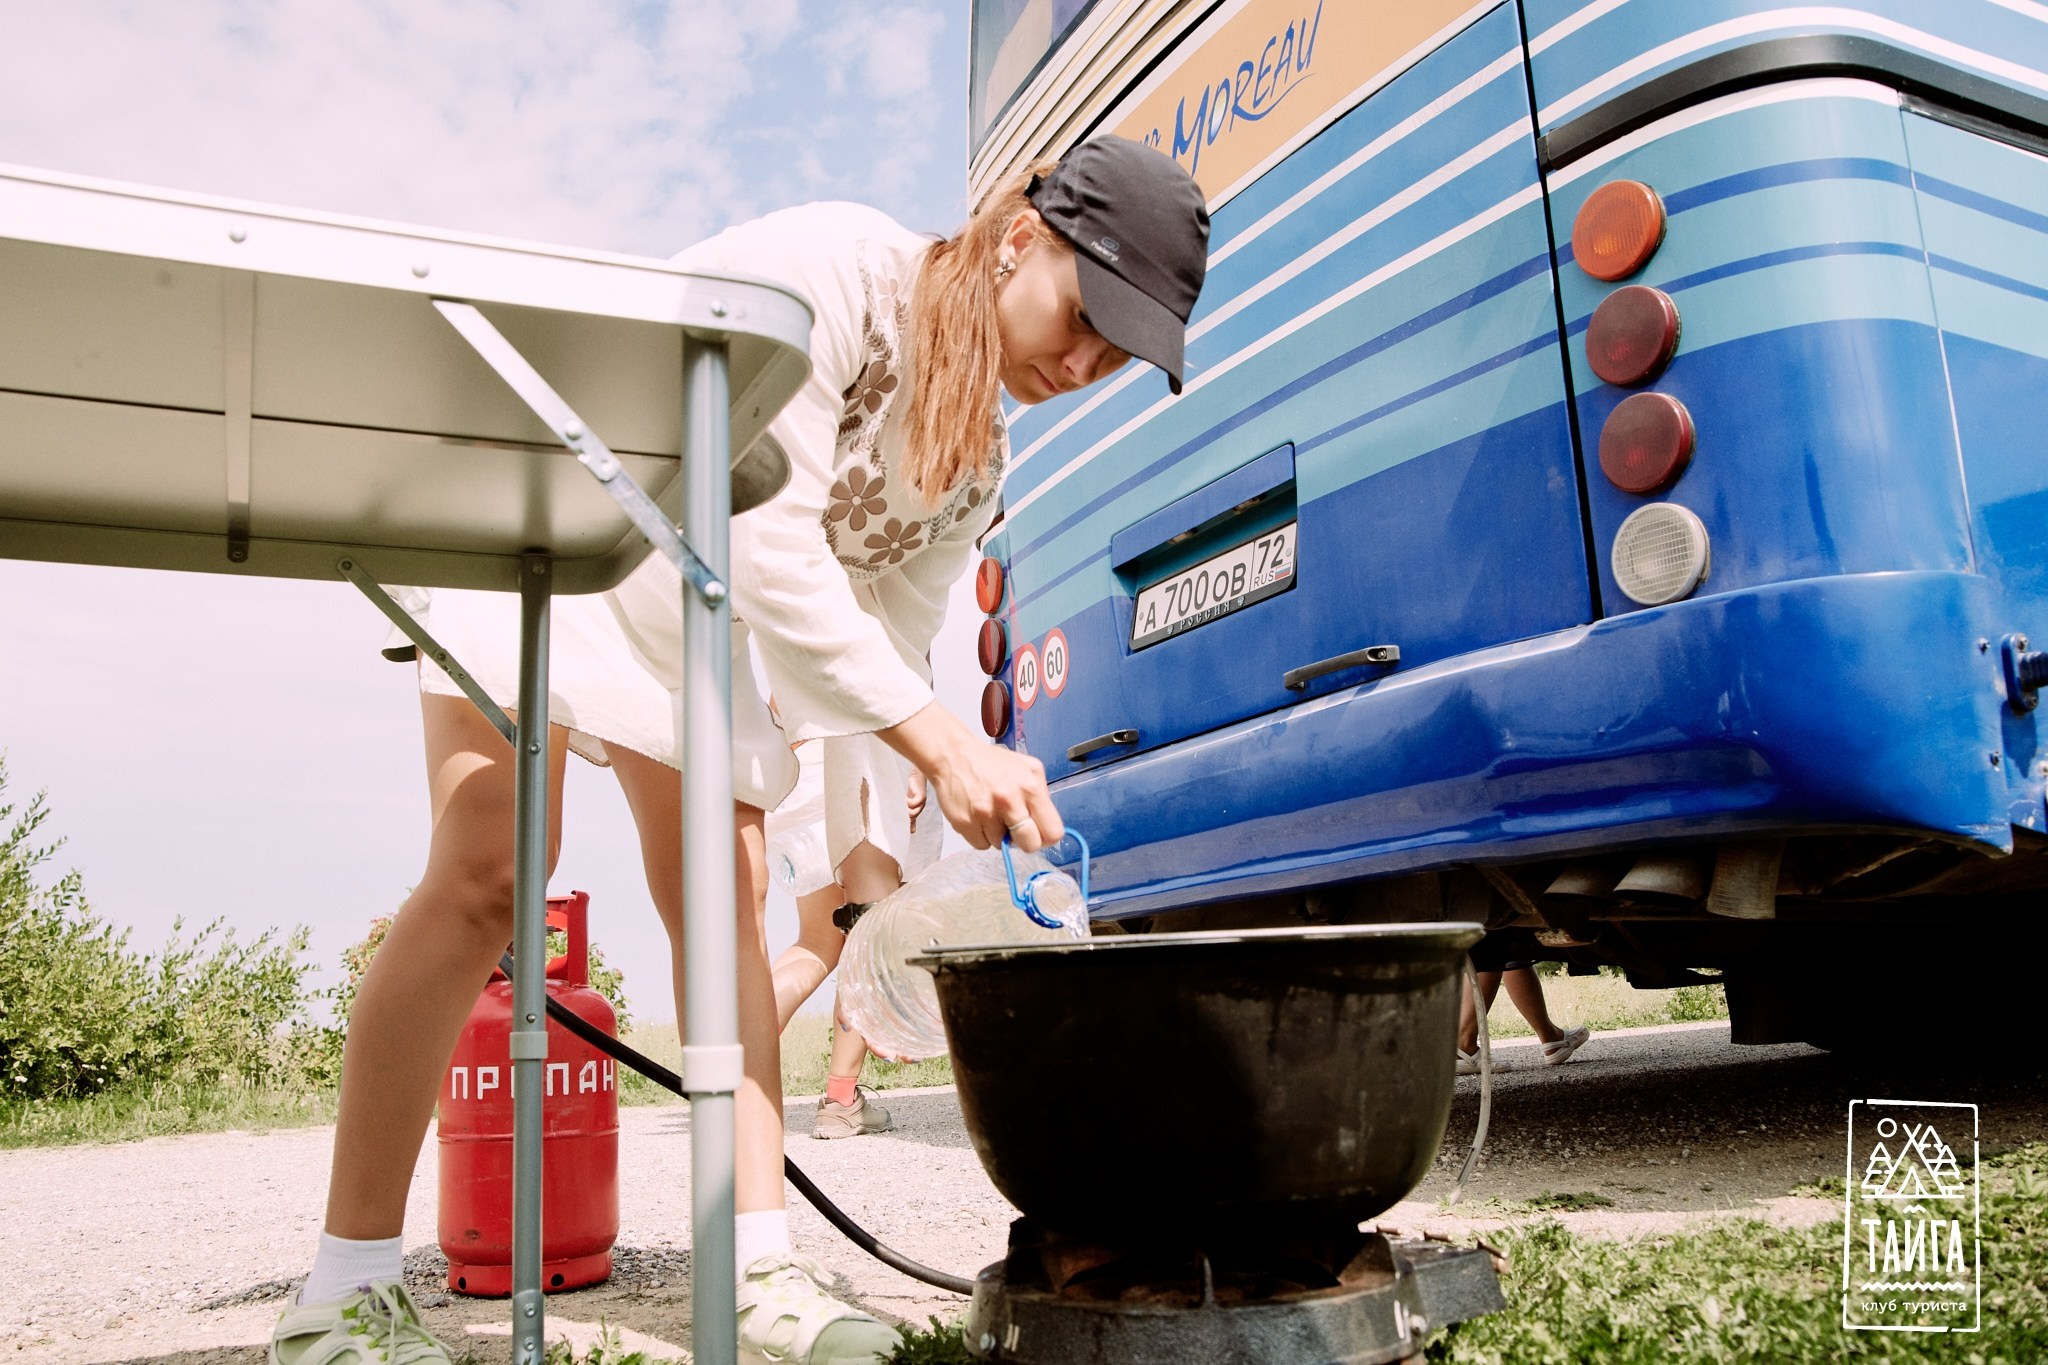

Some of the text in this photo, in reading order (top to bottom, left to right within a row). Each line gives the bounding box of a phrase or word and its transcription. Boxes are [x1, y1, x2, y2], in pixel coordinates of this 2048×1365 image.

[1172, 0, 1323, 178] MOREAU
[1257, 534, 1285, 574] 72
[1253, 570, 1274, 588] RUS
[1179, 600, 1231, 630] РОССИЯ
[1019, 660, 1035, 691] 40
[1046, 646, 1063, 680] 60
[452, 1059, 614, 1100] ПРПАН
